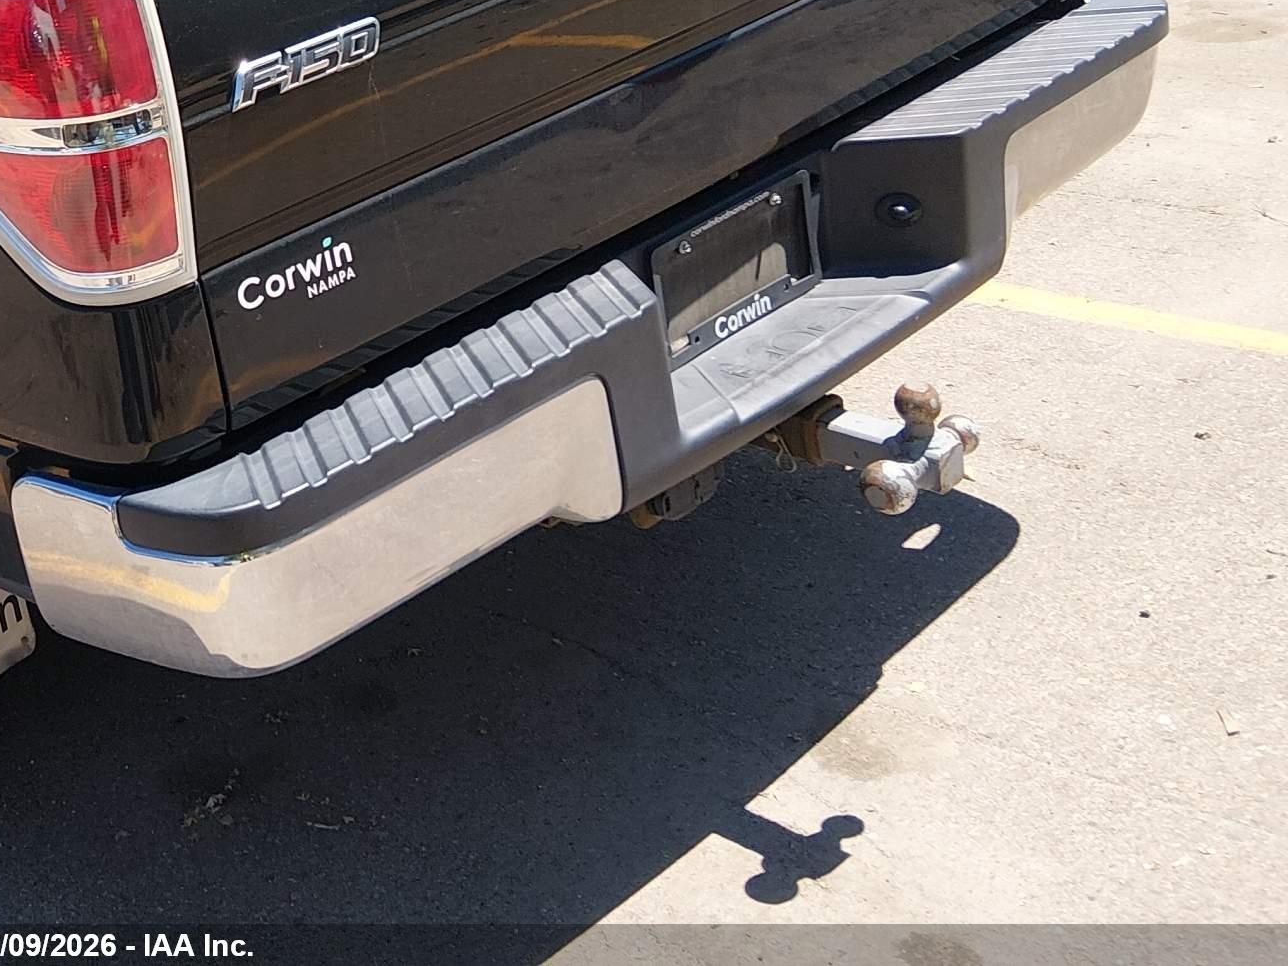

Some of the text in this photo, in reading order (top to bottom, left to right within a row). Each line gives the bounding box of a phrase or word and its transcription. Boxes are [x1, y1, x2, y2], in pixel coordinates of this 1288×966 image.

[237, 236, 354, 310] Corwin
[307, 266, 357, 299] NAMPA
[715, 293, 773, 339] Corwin
